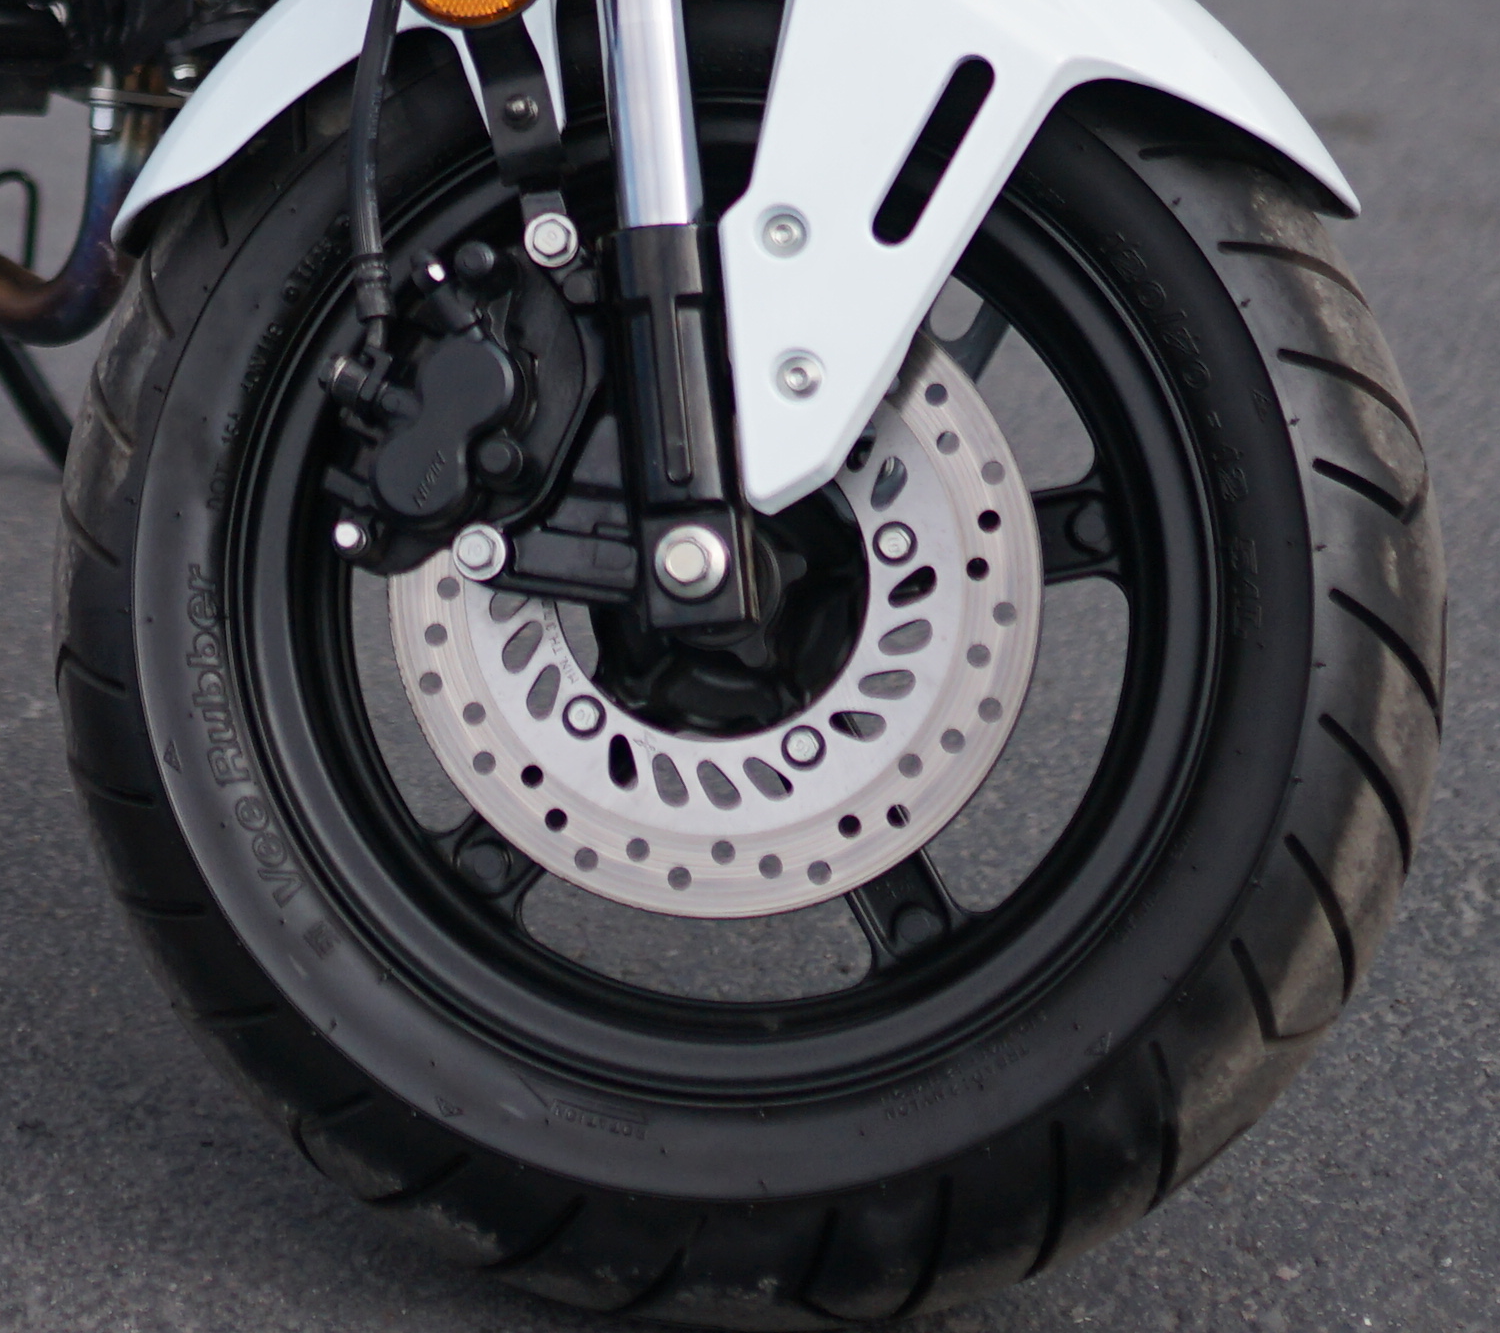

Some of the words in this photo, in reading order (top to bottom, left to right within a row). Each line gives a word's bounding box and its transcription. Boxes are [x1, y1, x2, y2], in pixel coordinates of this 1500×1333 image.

[1100, 231, 1213, 391] 120/70
[208, 463, 230, 511] DOT
[187, 566, 252, 787] Rubber
[235, 796, 308, 908] Vee
